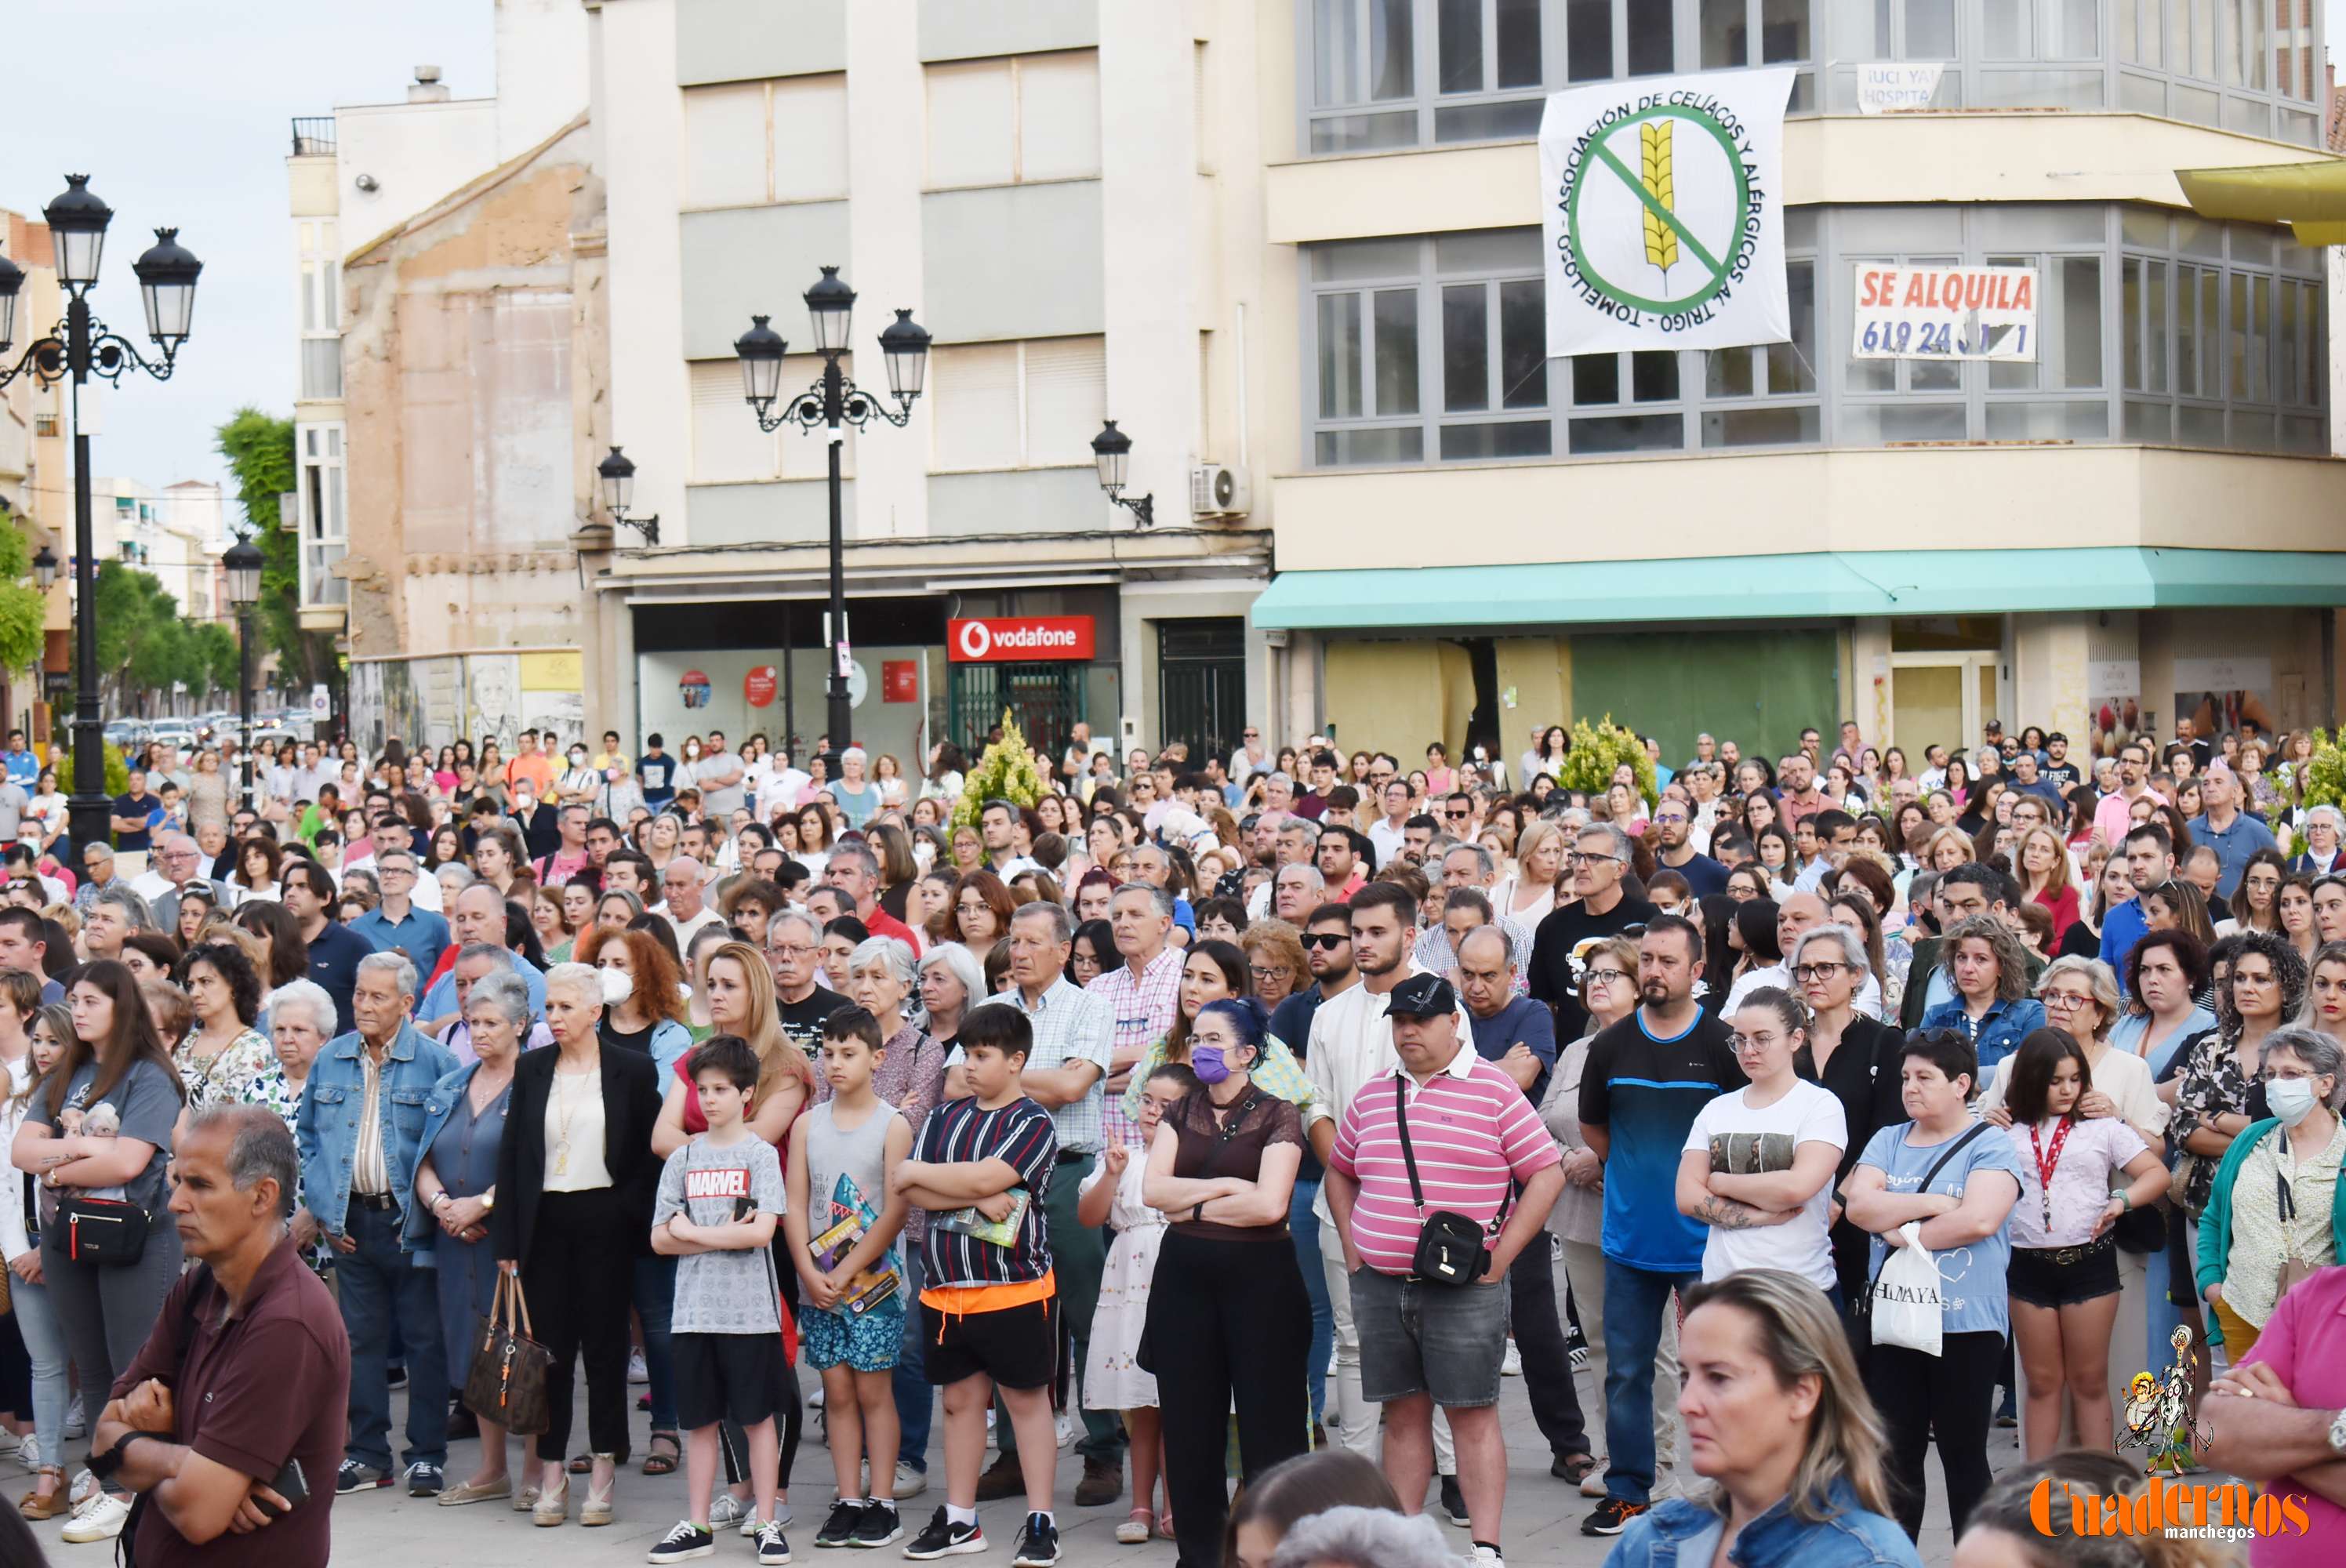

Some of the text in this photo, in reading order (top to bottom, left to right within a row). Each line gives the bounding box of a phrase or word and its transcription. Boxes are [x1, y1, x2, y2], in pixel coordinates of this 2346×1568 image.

[1638, 93, 1663, 111] DE
[1669, 90, 1745, 141] CELÍACOS
[1558, 103, 1631, 213] ASOCIACIÓN
[1738, 140, 1754, 155] Y
[1730, 164, 1766, 284] ALÉRGICOS
[1557, 234, 1641, 328] TOMELLOSO
[1712, 281, 1732, 307] AL
[1861, 271, 2032, 313] SE ALQUILA
[1660, 303, 1716, 332] TRIGO
[1863, 321, 1912, 353] 619
[1918, 322, 1951, 354] 24
[993, 626, 1077, 648] vodafone
[688, 1170, 746, 1197] MARVEL
[821, 1221, 858, 1250] forum
